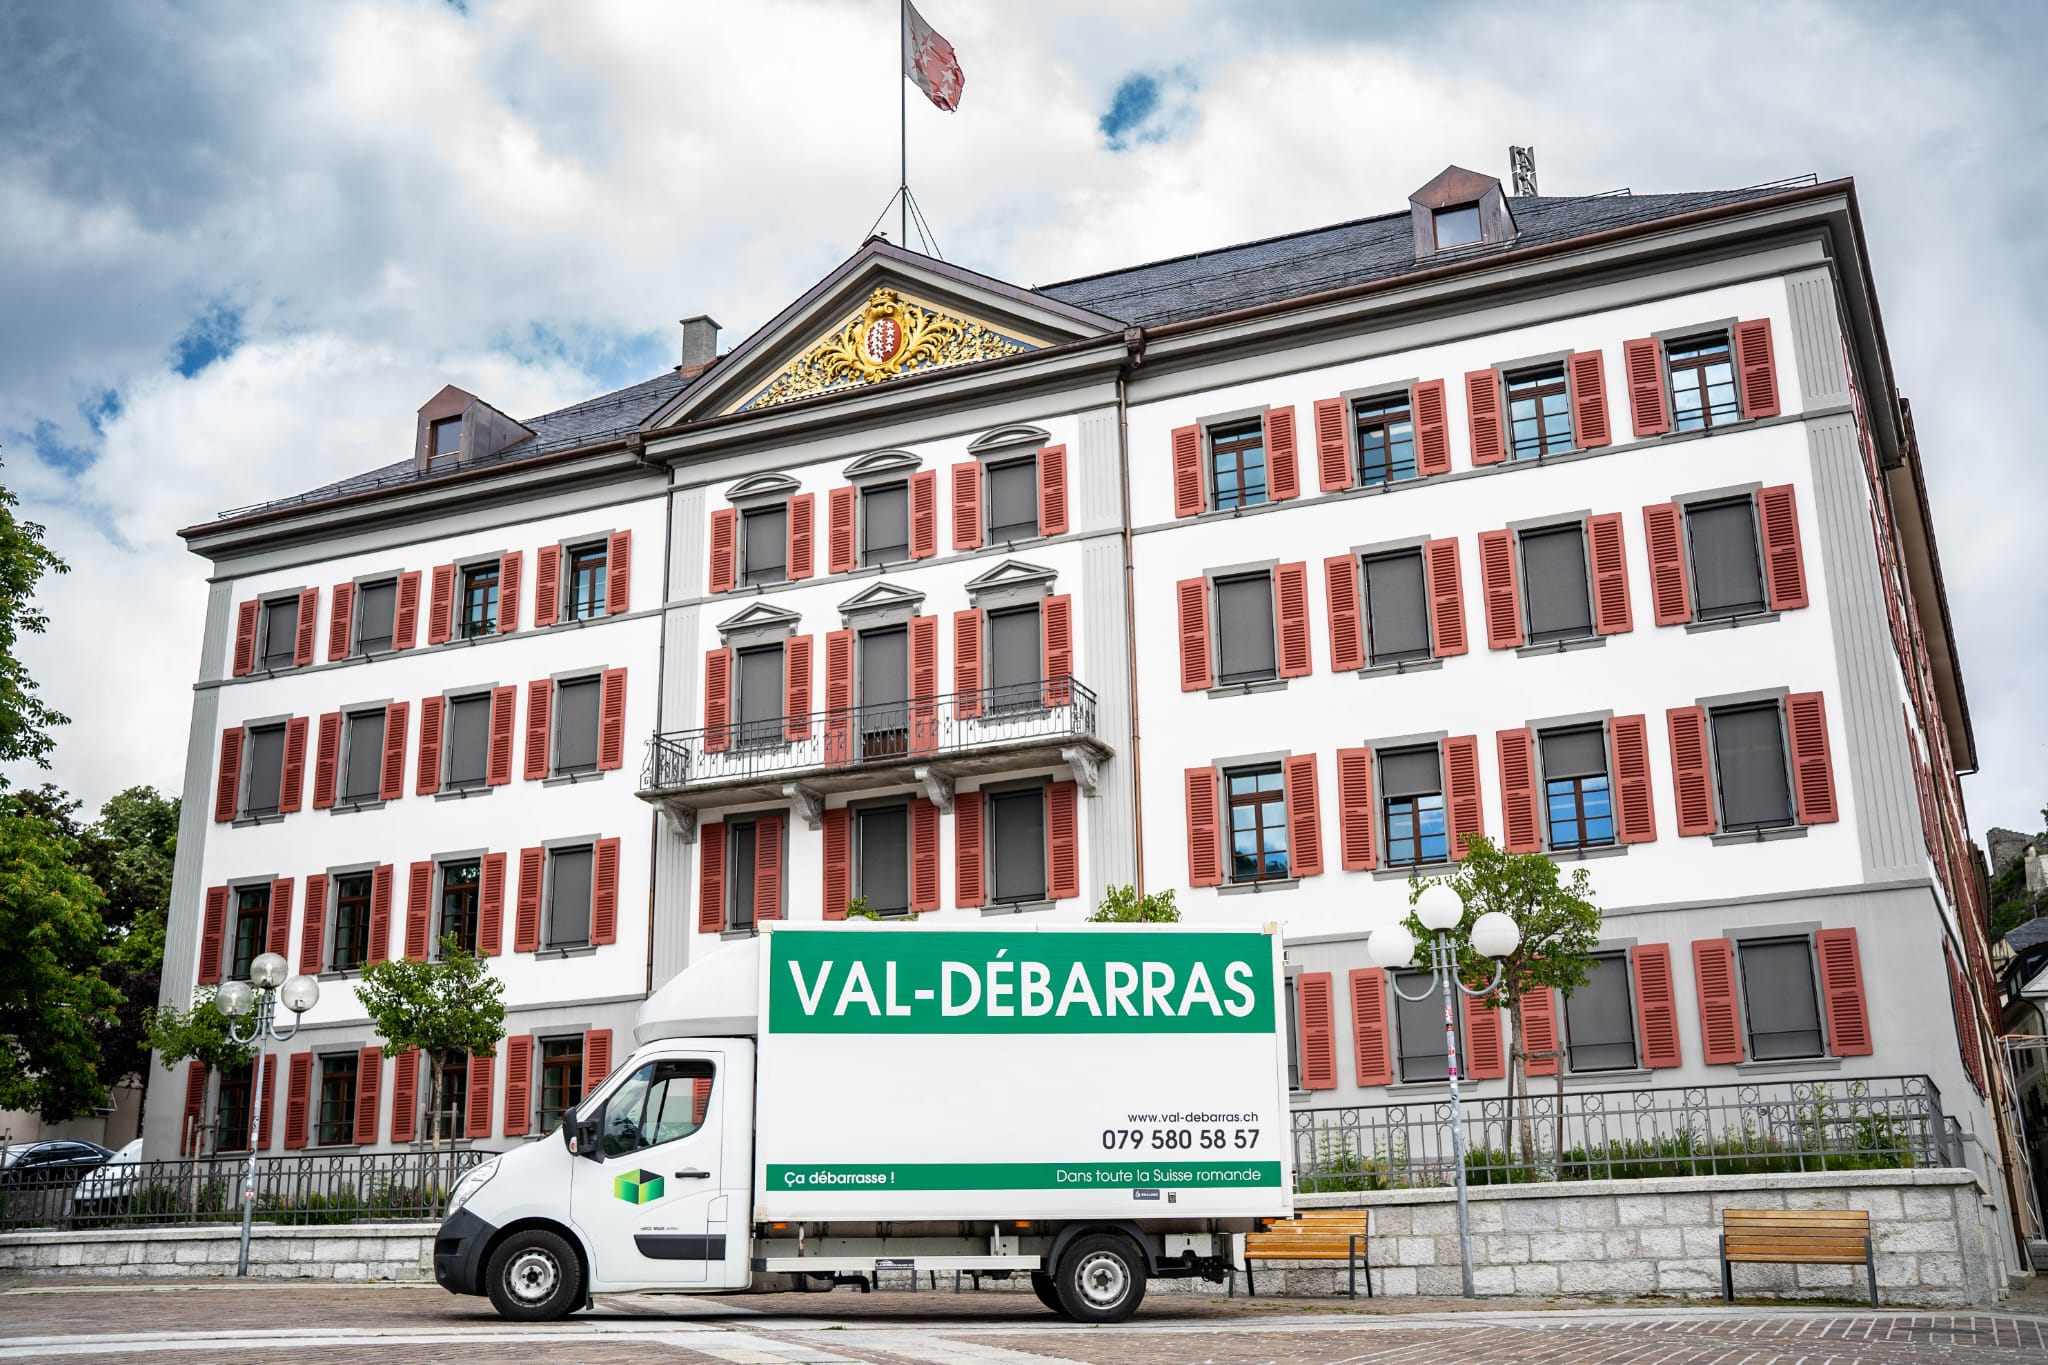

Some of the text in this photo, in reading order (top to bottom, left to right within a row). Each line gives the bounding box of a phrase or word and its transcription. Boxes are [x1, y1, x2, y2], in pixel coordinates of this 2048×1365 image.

[788, 948, 1256, 1018] VAL-DÉBARRAS
[1127, 1111, 1259, 1123] www.val-debarras.ch
[1102, 1128, 1260, 1150] 079 580 58 57
[784, 1170, 806, 1187] Ça
[808, 1170, 887, 1185] débarrasse
[1056, 1168, 1262, 1183] Dans toute la Suisse romande
